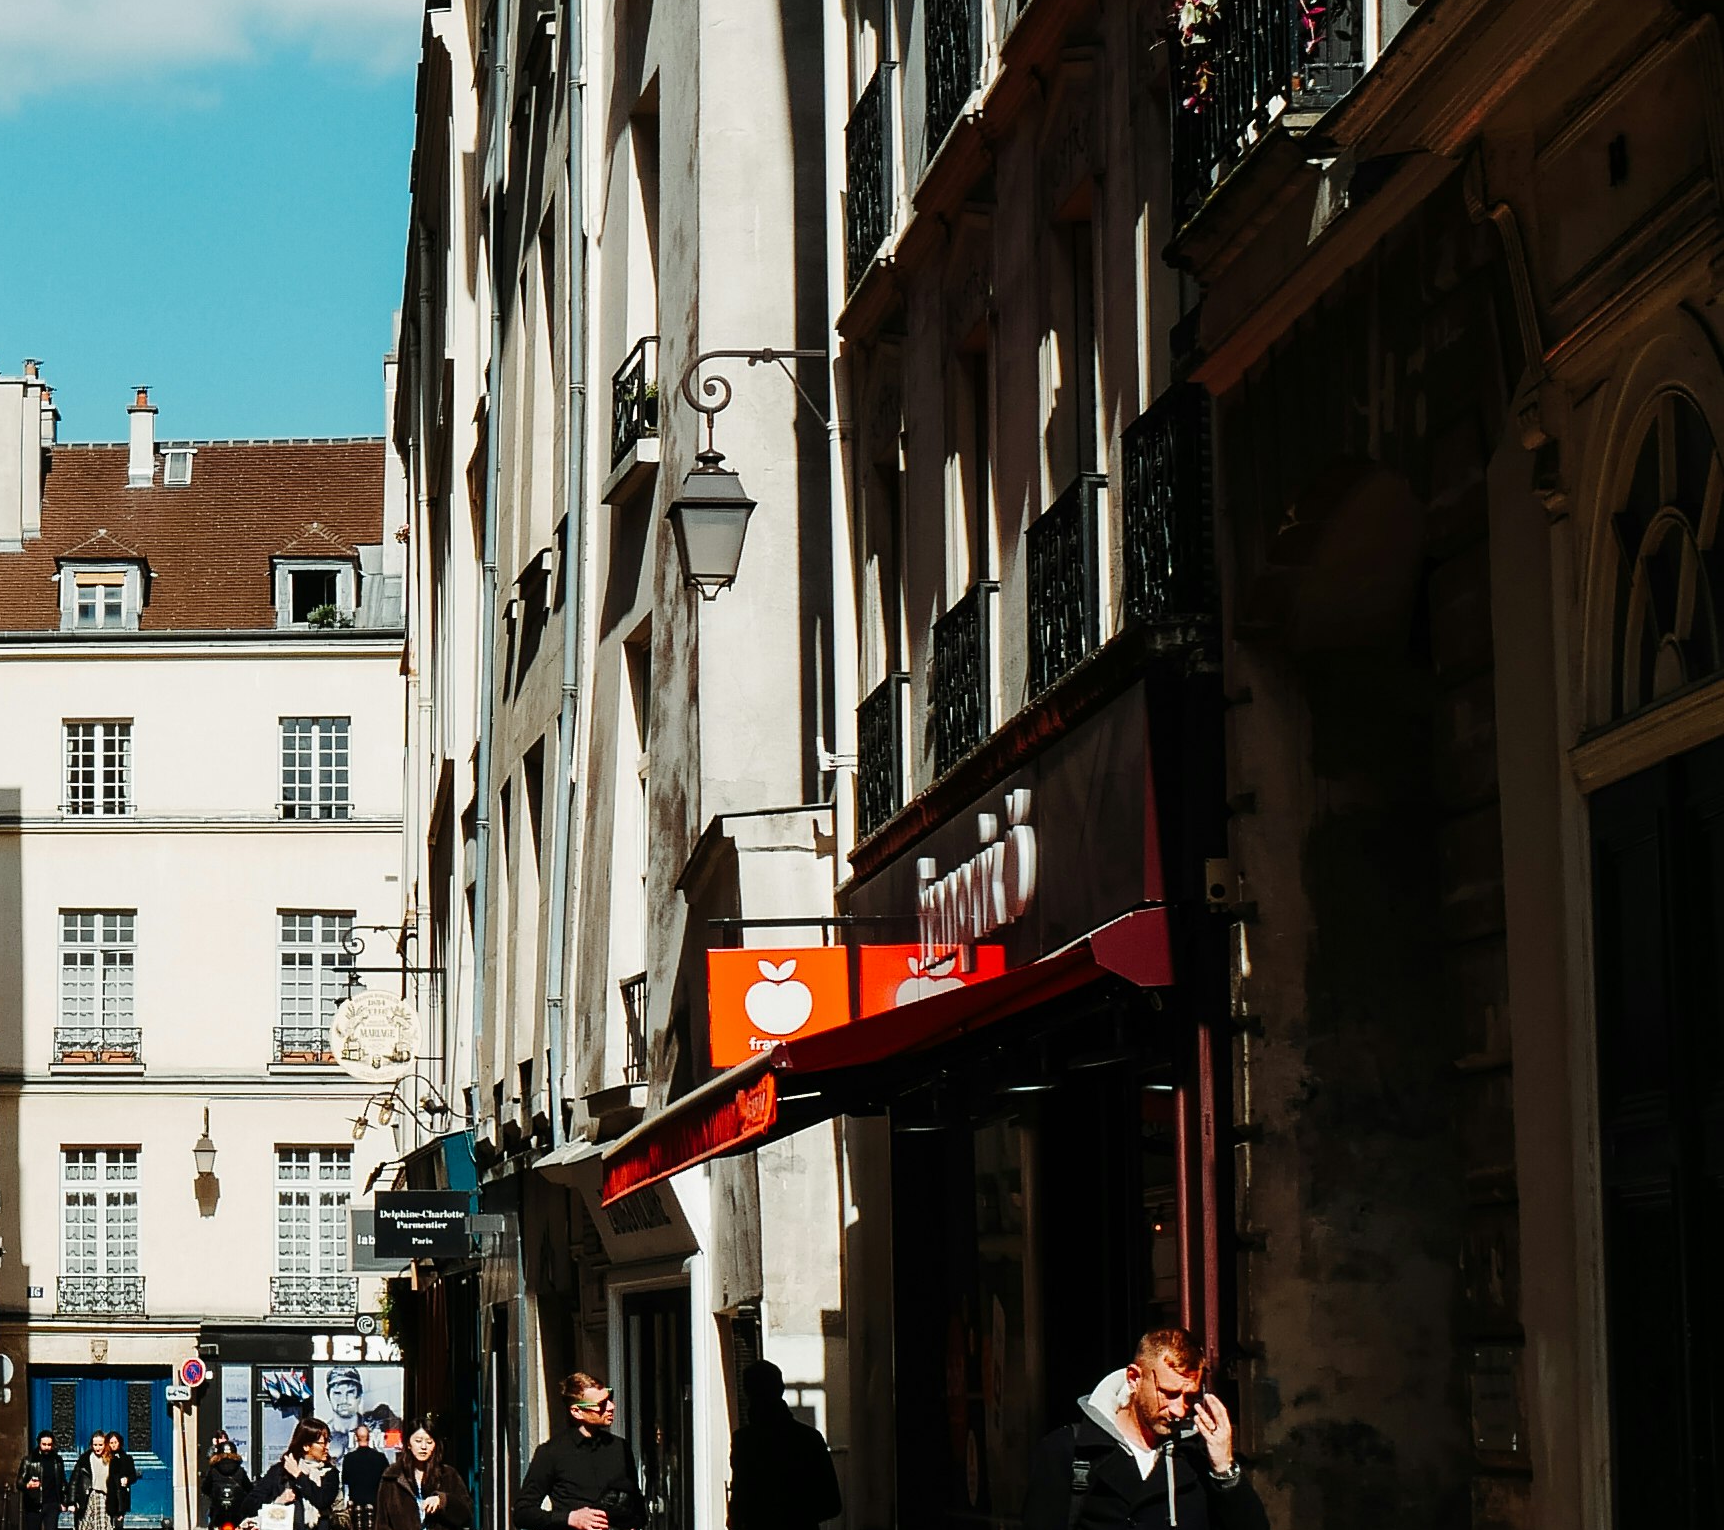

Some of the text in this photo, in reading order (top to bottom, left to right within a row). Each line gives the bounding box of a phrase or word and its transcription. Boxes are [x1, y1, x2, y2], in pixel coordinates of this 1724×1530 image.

[360, 1028, 396, 1039] MARIAGE
[379, 1209, 465, 1221] Delphine-Charlotte
[396, 1220, 448, 1230] Parmentier
[411, 1237, 434, 1245] Paris
[310, 1335, 404, 1361] IEM
